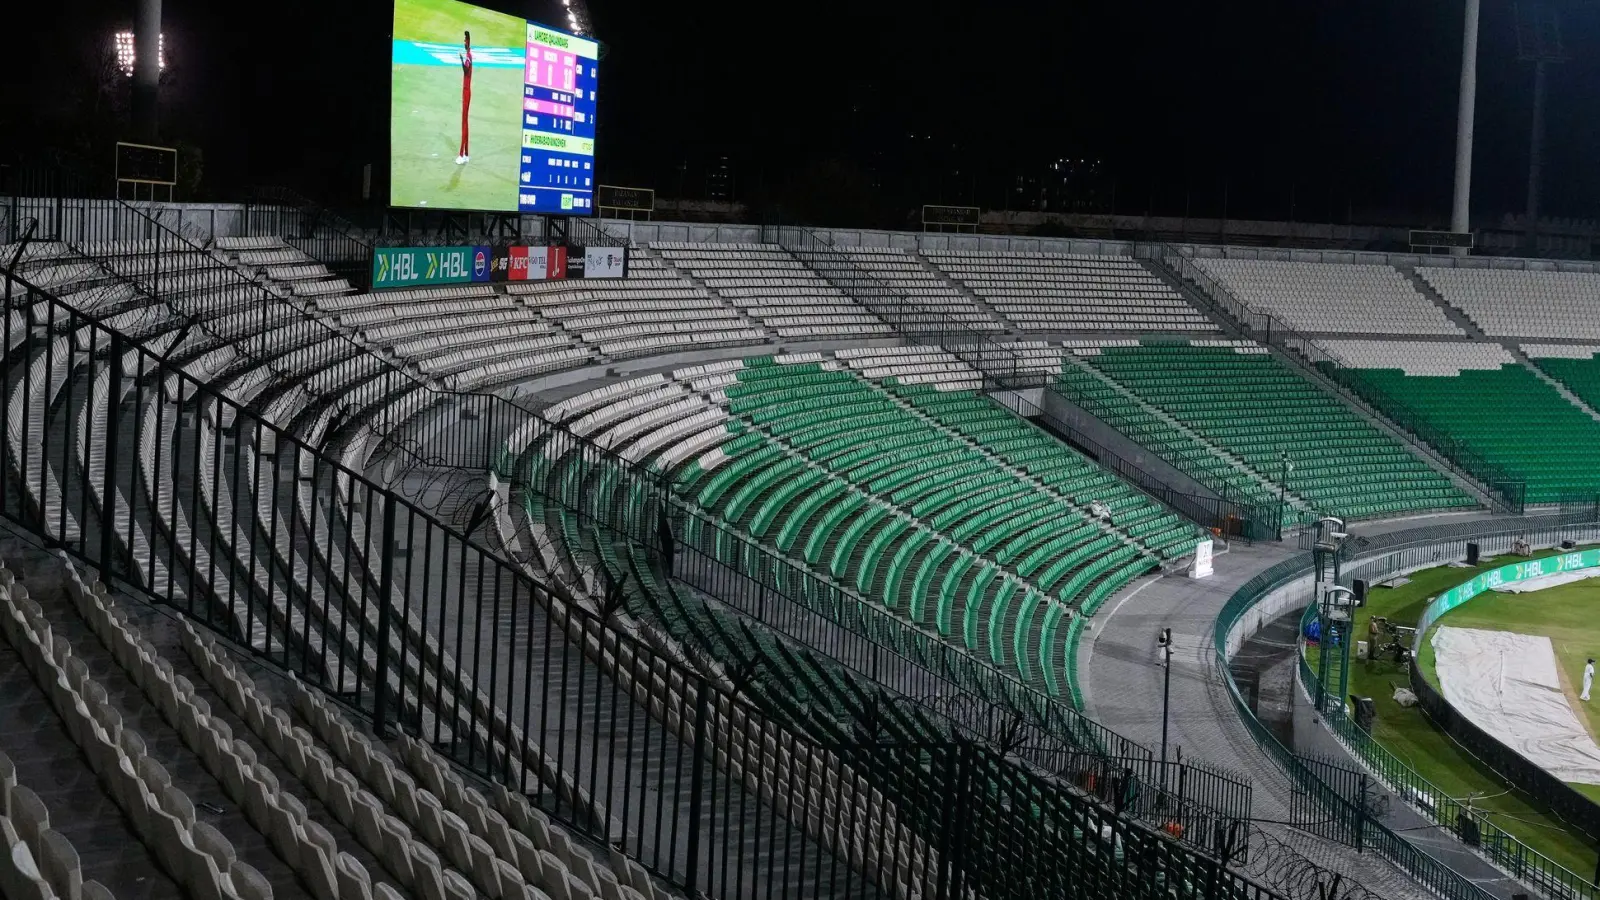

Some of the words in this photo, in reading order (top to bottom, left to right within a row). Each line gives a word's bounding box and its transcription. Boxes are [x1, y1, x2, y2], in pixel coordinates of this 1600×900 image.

[391, 253, 418, 281] HBL
[440, 252, 468, 278] HBL
[513, 256, 528, 270] KFC
[1524, 560, 1544, 577] HBL
[1565, 552, 1584, 569] HBL
[1487, 569, 1503, 587] HBL
[1462, 581, 1475, 599] HBL
